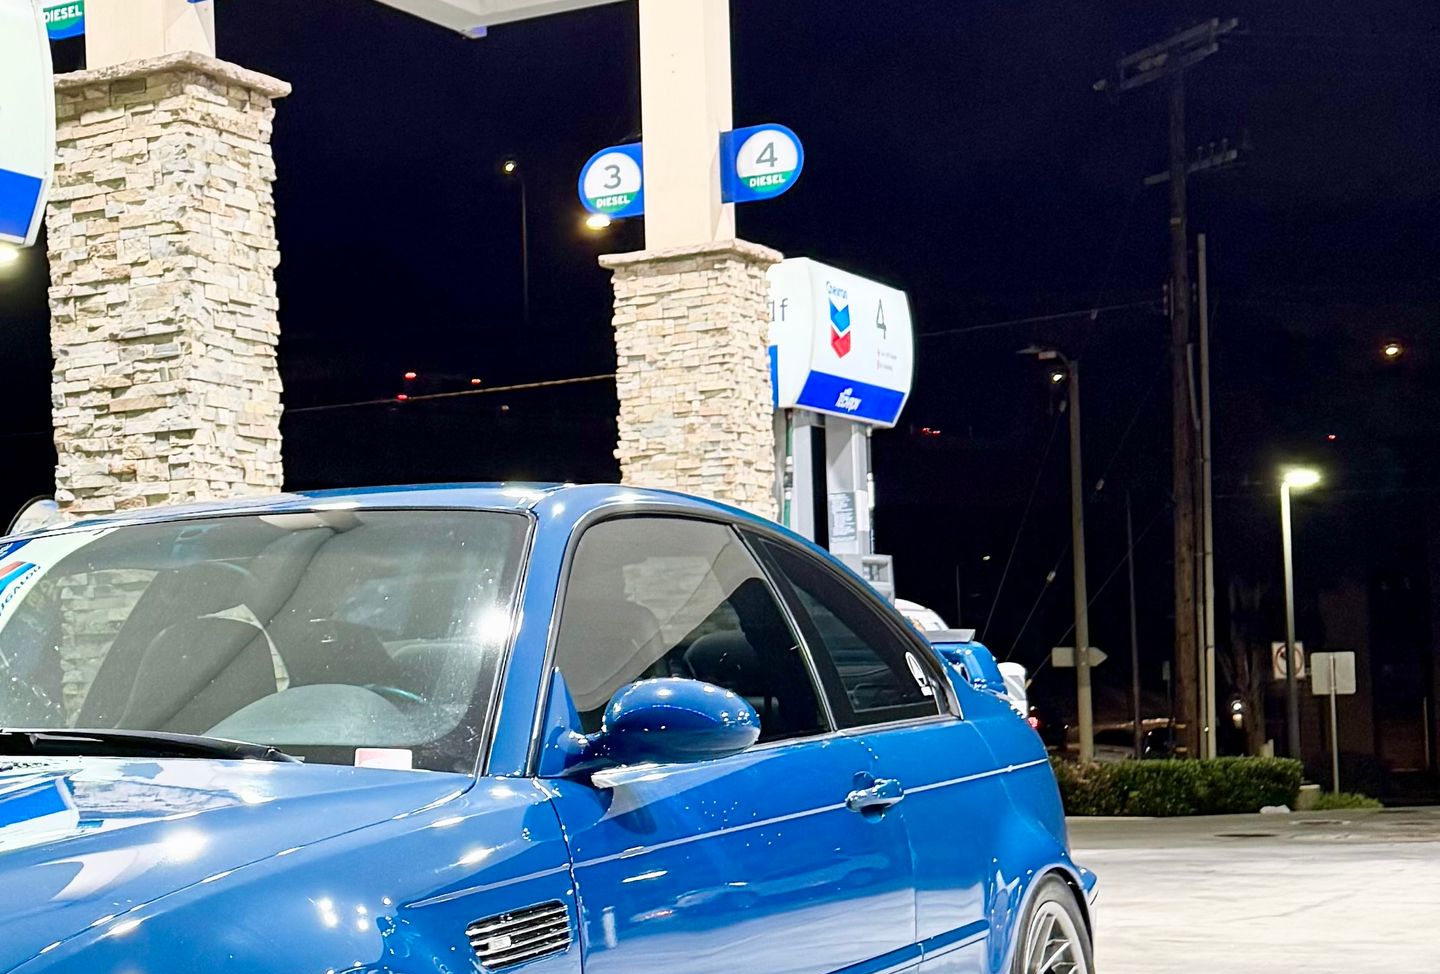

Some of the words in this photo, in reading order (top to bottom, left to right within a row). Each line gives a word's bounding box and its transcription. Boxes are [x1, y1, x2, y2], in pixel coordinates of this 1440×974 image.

[44, 5, 83, 23] DIESEL
[755, 142, 778, 167] 4
[603, 164, 622, 189] 3
[749, 173, 787, 187] DIESEL
[596, 195, 631, 208] DIESEL
[876, 298, 887, 340] 4
